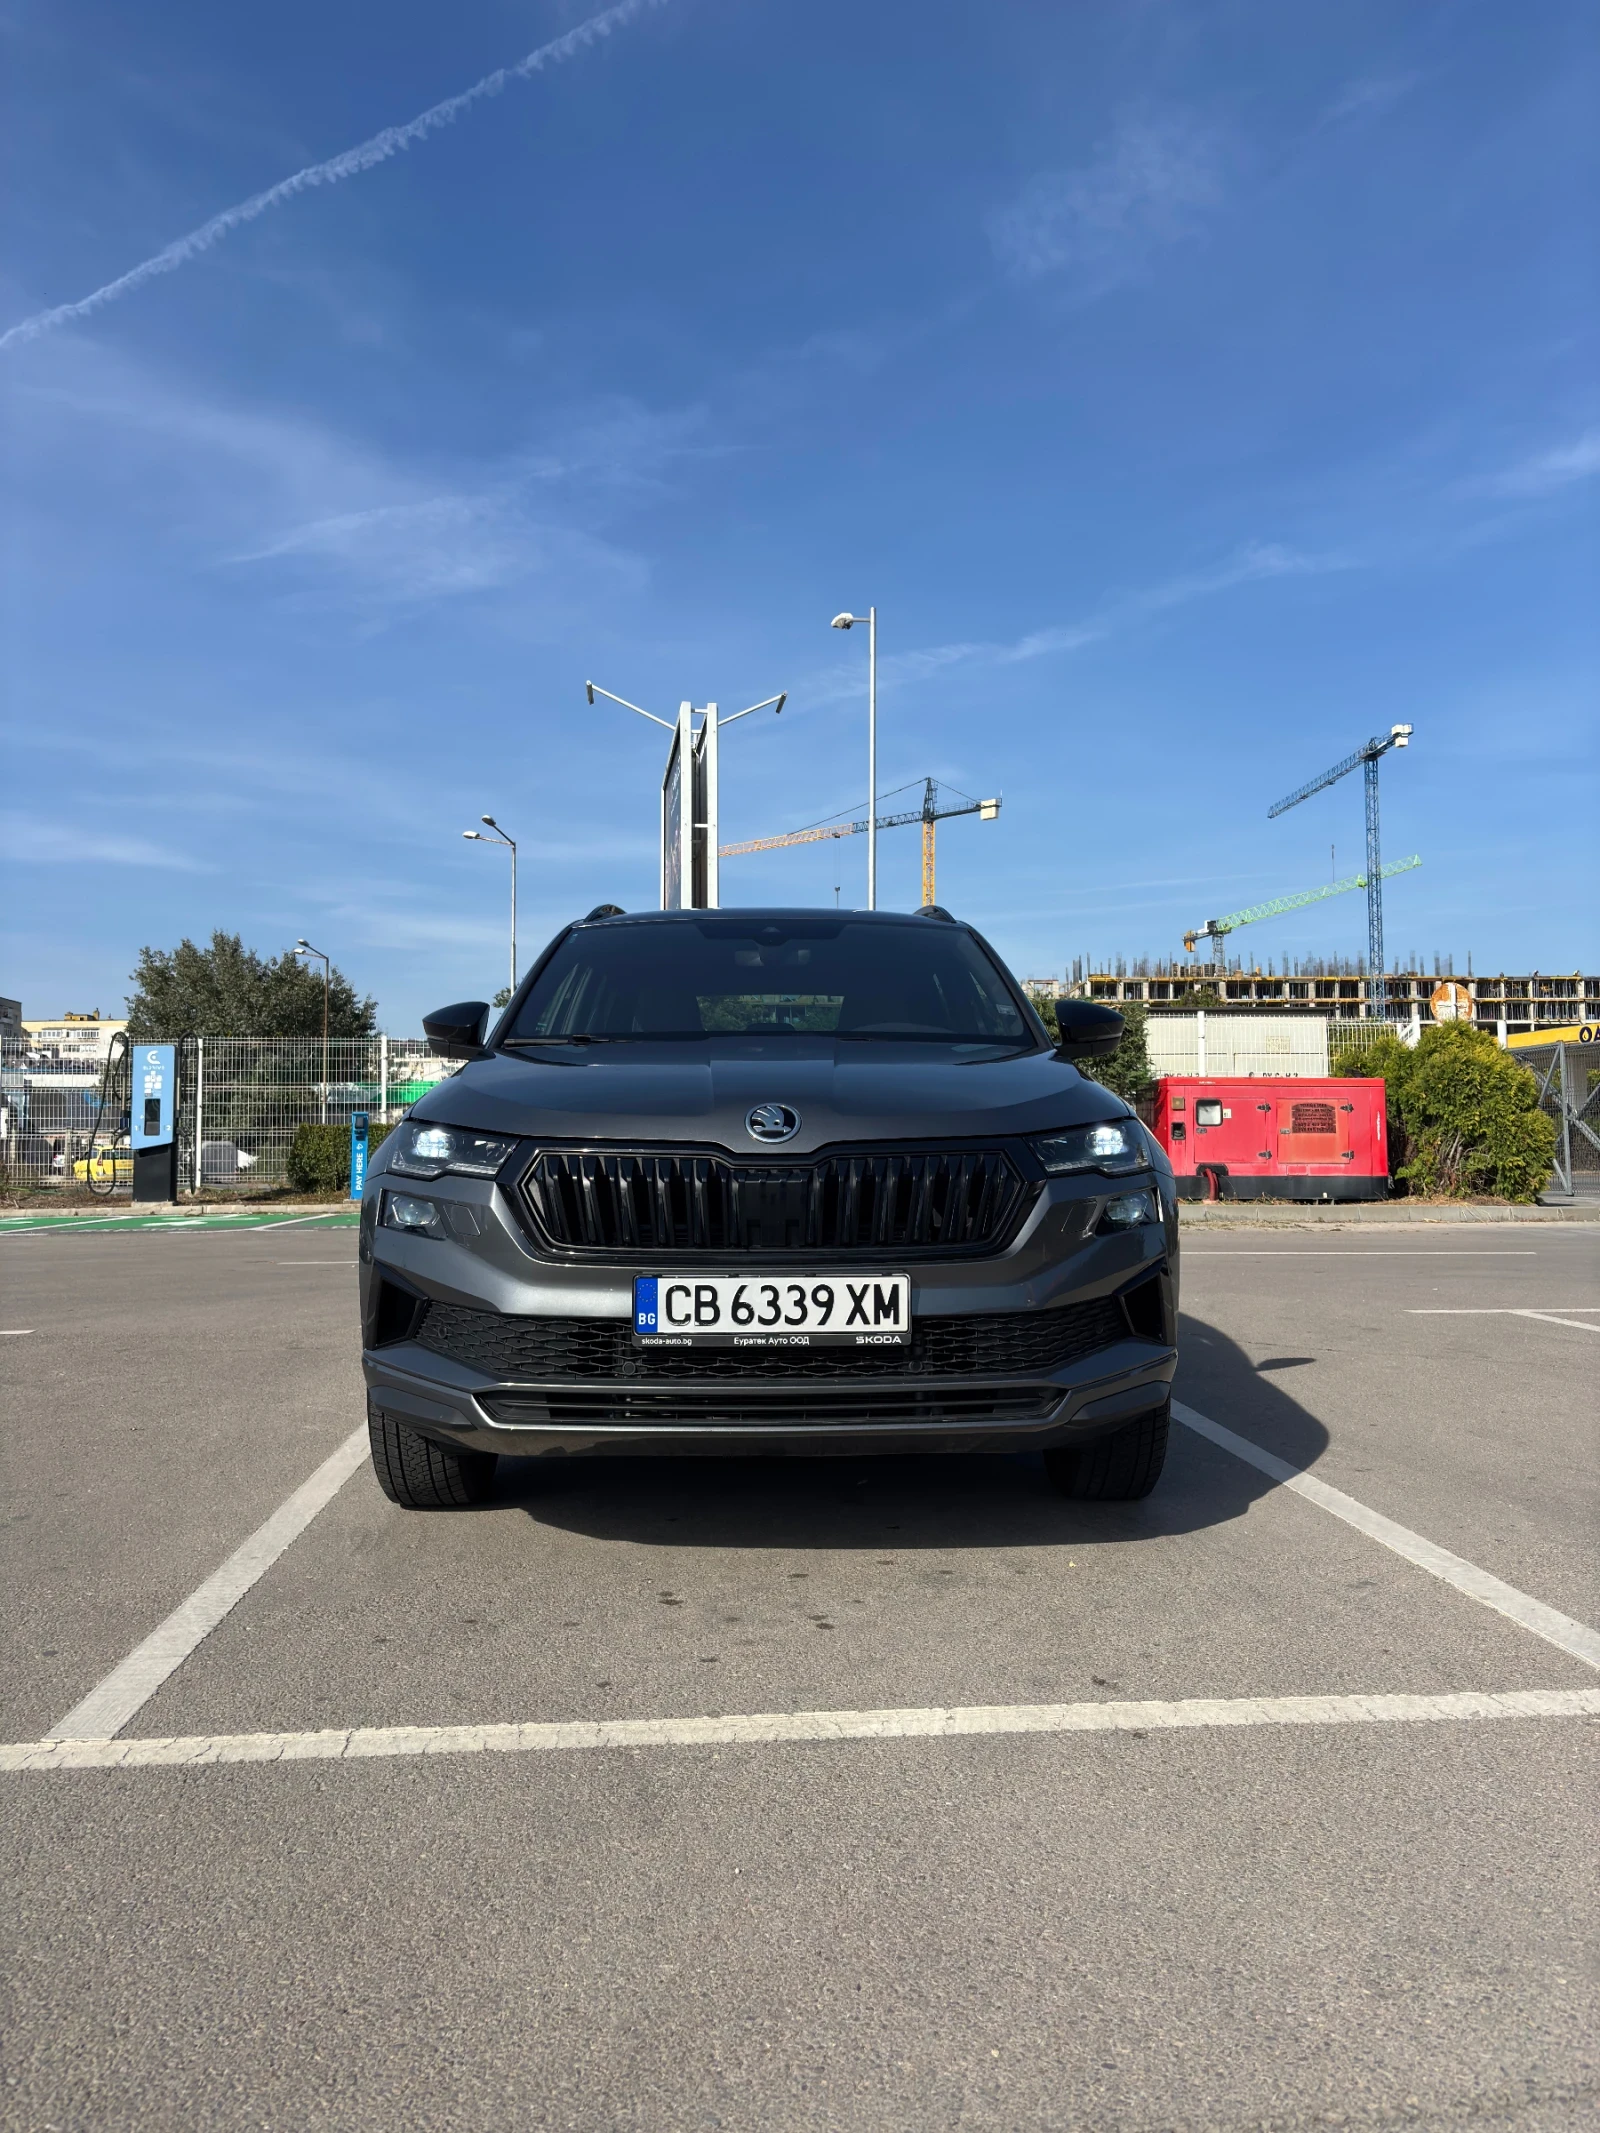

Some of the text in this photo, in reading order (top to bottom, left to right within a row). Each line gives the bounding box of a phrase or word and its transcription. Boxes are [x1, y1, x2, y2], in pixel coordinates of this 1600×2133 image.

[355, 1152, 364, 1190] PAY HERE
[665, 1283, 900, 1327] CB 6339 XM
[638, 1312, 656, 1325] BG
[641, 1337, 692, 1346] skoda-auto.bg
[733, 1336, 810, 1347] Еуратек Ауто ООД
